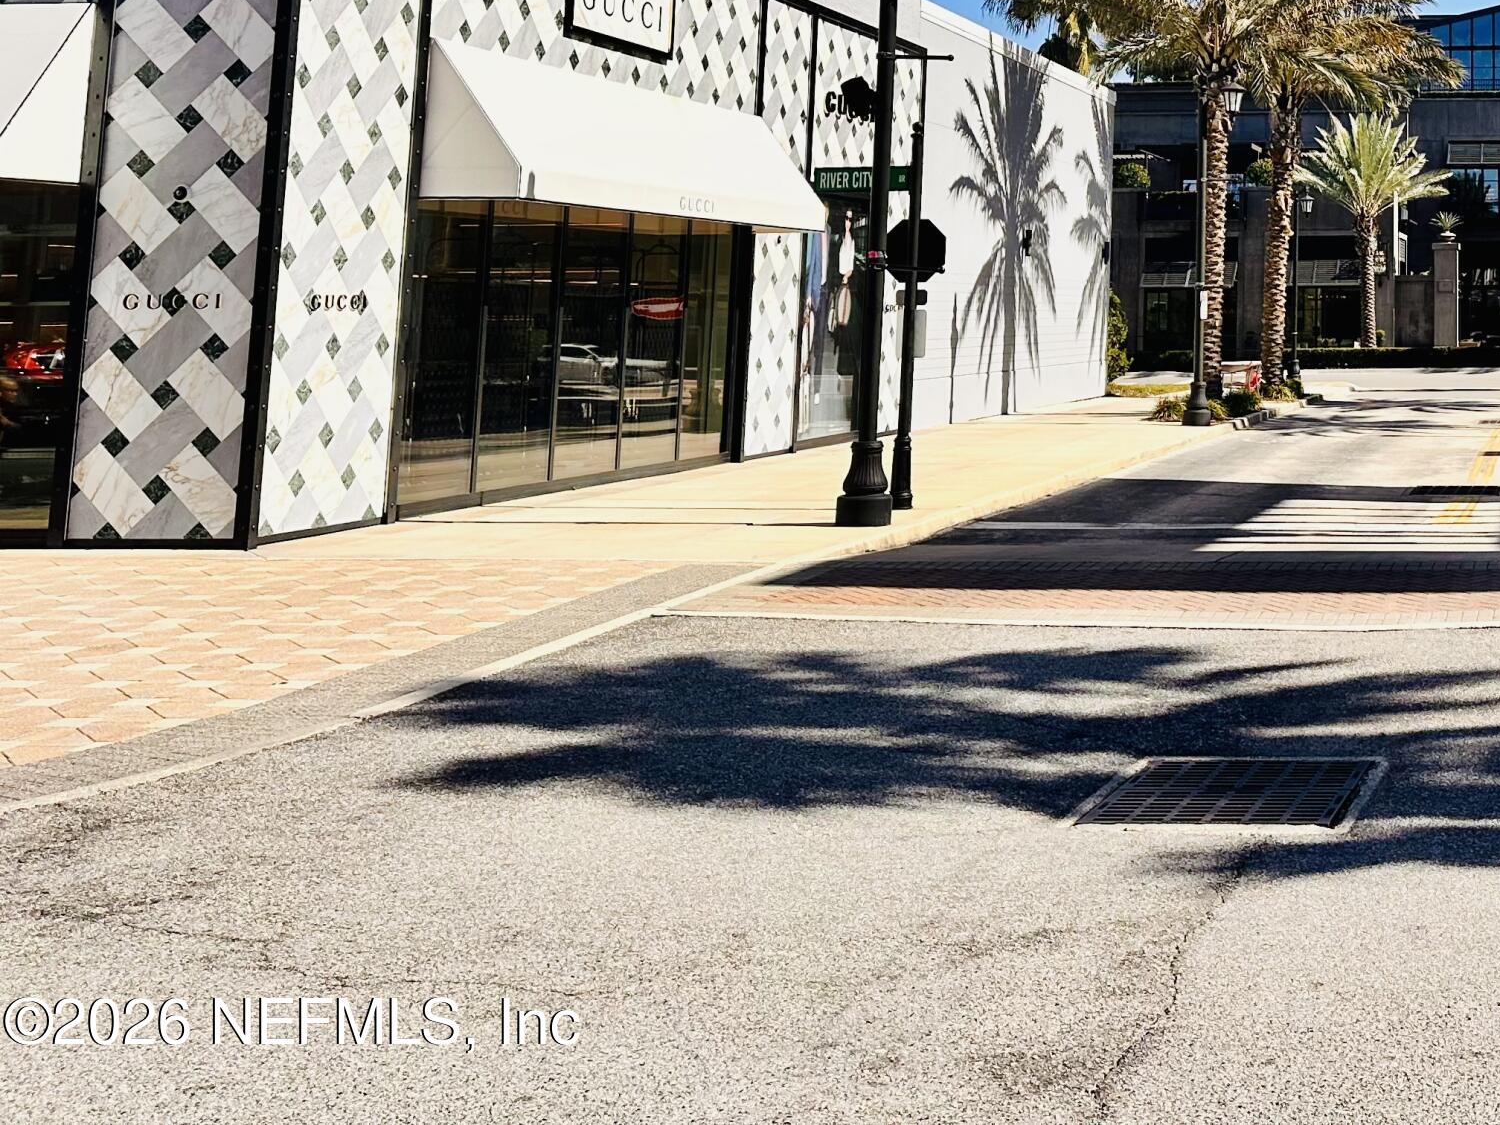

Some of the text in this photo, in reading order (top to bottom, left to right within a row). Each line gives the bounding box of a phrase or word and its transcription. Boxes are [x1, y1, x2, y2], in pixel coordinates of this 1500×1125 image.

[820, 172, 849, 189] RIVER
[122, 293, 222, 311] GUCCI
[310, 293, 368, 311] GUCCI
